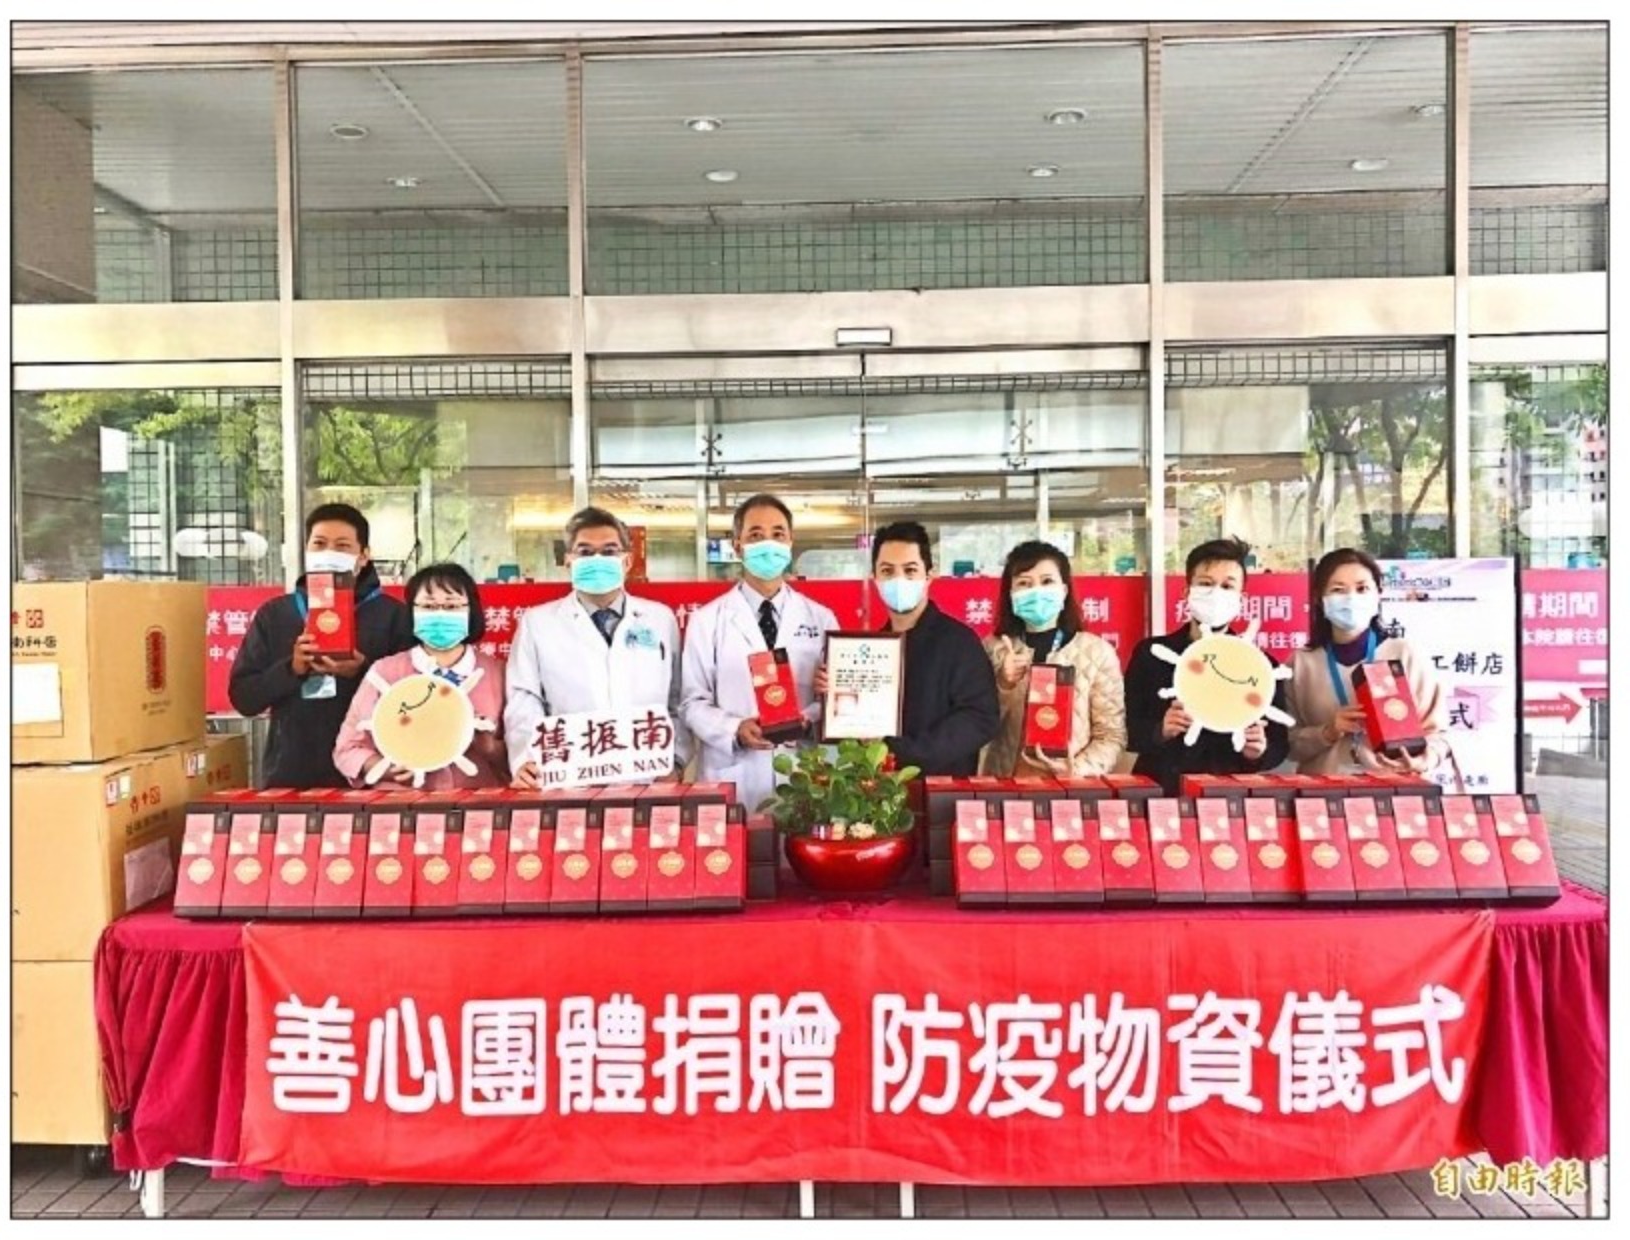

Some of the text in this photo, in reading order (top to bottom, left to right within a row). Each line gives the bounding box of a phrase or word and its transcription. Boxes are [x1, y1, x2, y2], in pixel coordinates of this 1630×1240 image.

[532, 710, 672, 765] 舊振南
[542, 756, 669, 785] JIU ZHEN NAN
[267, 985, 1466, 1118] 善心團體捐贈 防疫物資儀式
